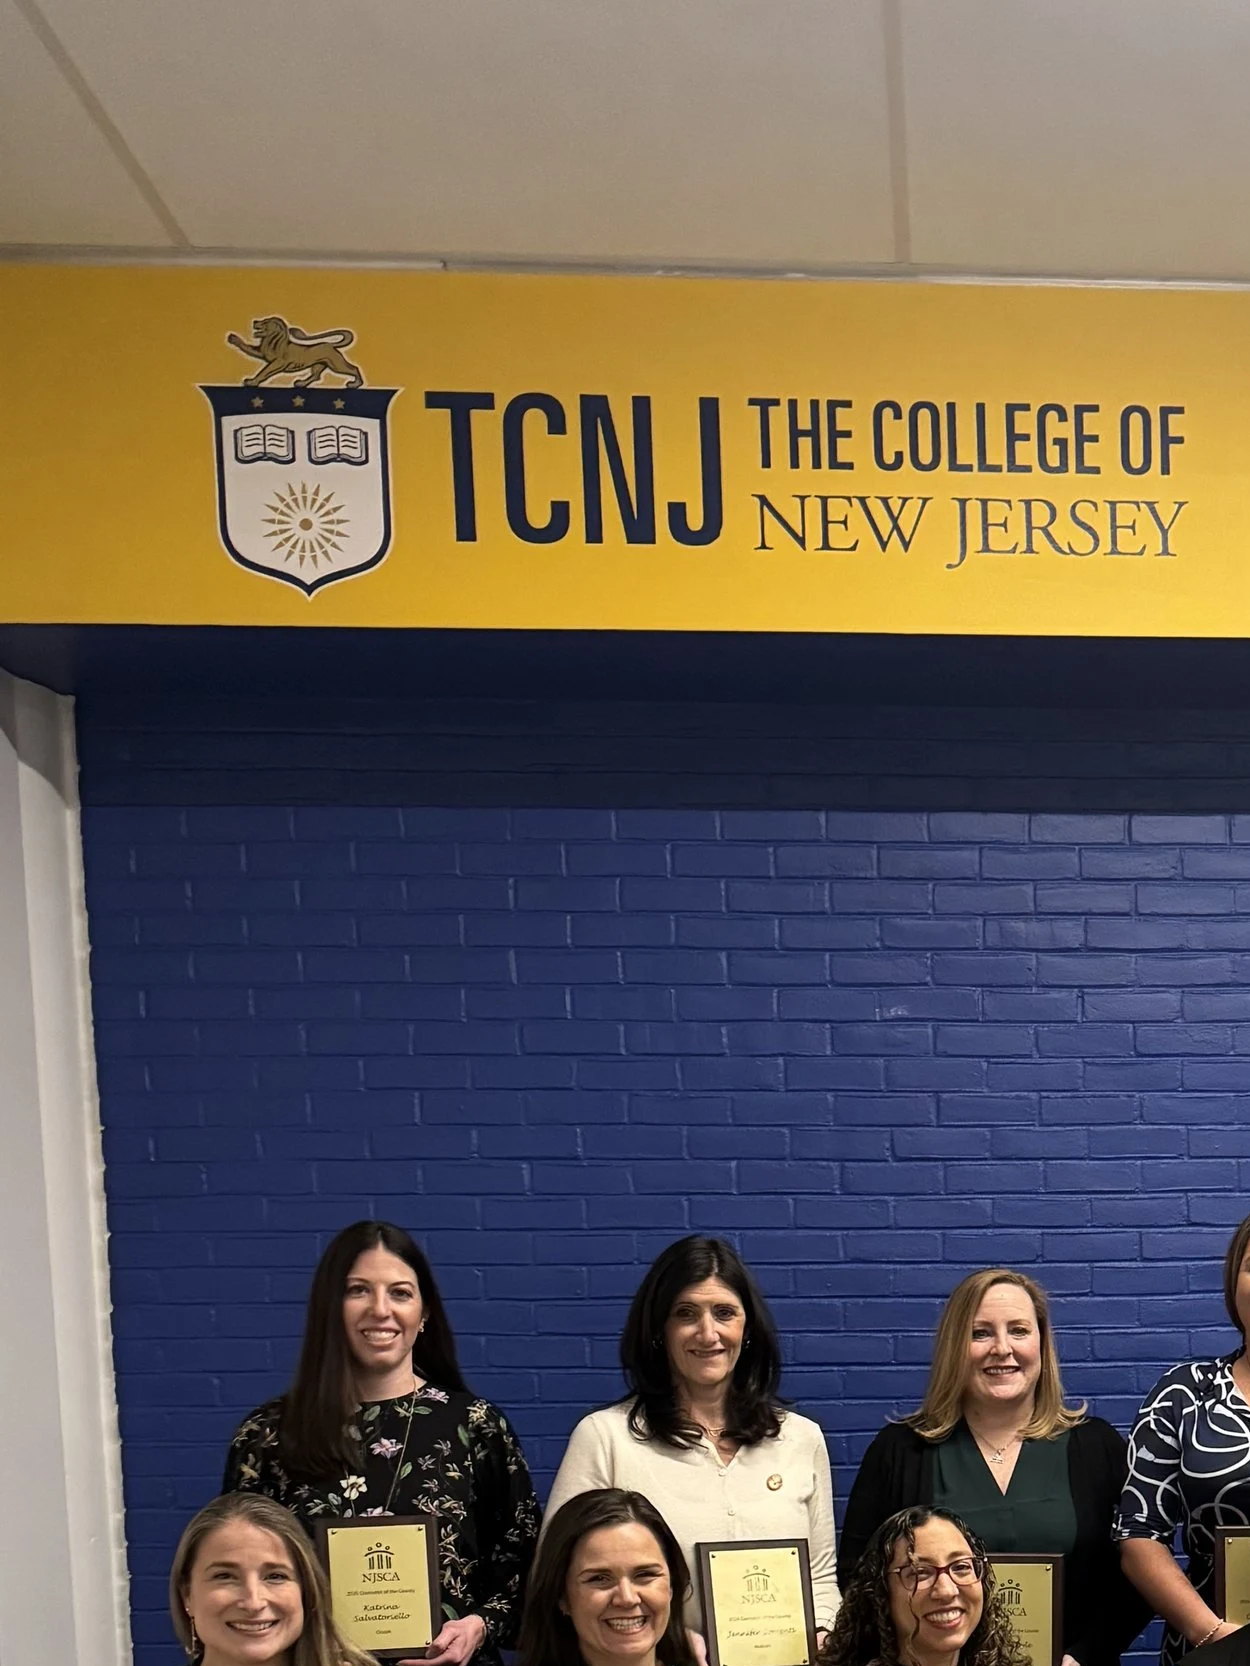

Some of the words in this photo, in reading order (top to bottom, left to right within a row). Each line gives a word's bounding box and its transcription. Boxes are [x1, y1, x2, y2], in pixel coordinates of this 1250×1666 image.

[747, 398, 853, 471] THE
[873, 400, 1100, 475] COLLEGE
[1121, 404, 1186, 476] OF
[424, 391, 723, 546] TCNJ
[752, 493, 931, 554] NEW
[946, 497, 1187, 570] JERSEY
[362, 1571, 400, 1583] NJSCA
[741, 1593, 777, 1605] NJSCA
[1001, 1607, 1027, 1617] SCA
